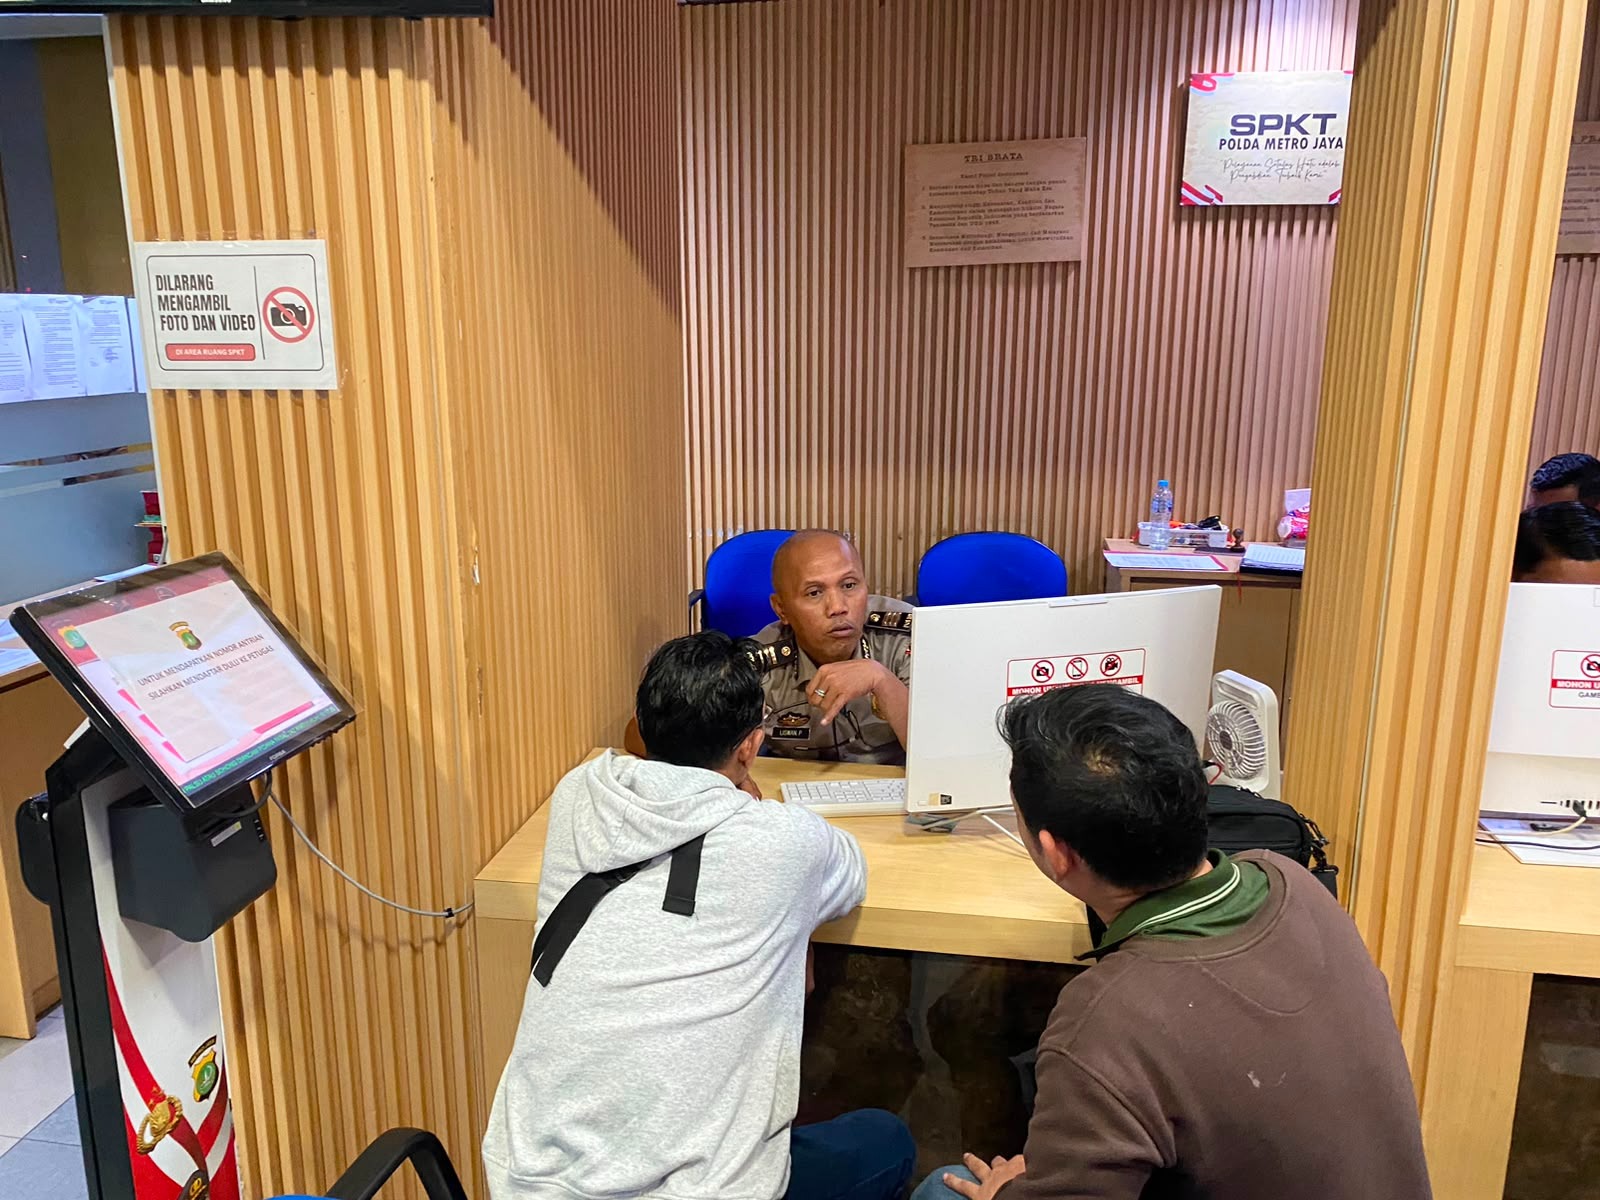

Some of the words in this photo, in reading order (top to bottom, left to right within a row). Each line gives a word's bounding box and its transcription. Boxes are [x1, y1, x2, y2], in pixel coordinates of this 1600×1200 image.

[1230, 113, 1337, 136] SPKT
[1219, 138, 1259, 150] POLDA
[1264, 137, 1308, 150] METRO
[1312, 137, 1343, 150] JAYA
[964, 154, 984, 163] TRI
[987, 153, 1023, 162] BRATA
[155, 274, 214, 291] DILARANG
[157, 294, 231, 311] MENGAMBIL
[160, 315, 189, 331] FOTO
[192, 315, 216, 331] DAN
[219, 314, 256, 331] VIDEO
[137, 671, 164, 686] UNTUK
[163, 652, 213, 678] MENDAPATKAN
[211, 640, 239, 658] NOMOR
[237, 633, 265, 649] ANTRIAN
[148, 680, 185, 700] SILAHKAN
[183, 666, 224, 687] MENDAFTAR
[222, 658, 241, 671] DULU
[239, 654, 249, 665] KE
[248, 645, 274, 661] PETUGAS
[1011, 686, 1042, 695] MOHON
[1557, 680, 1591, 688] MOHON
